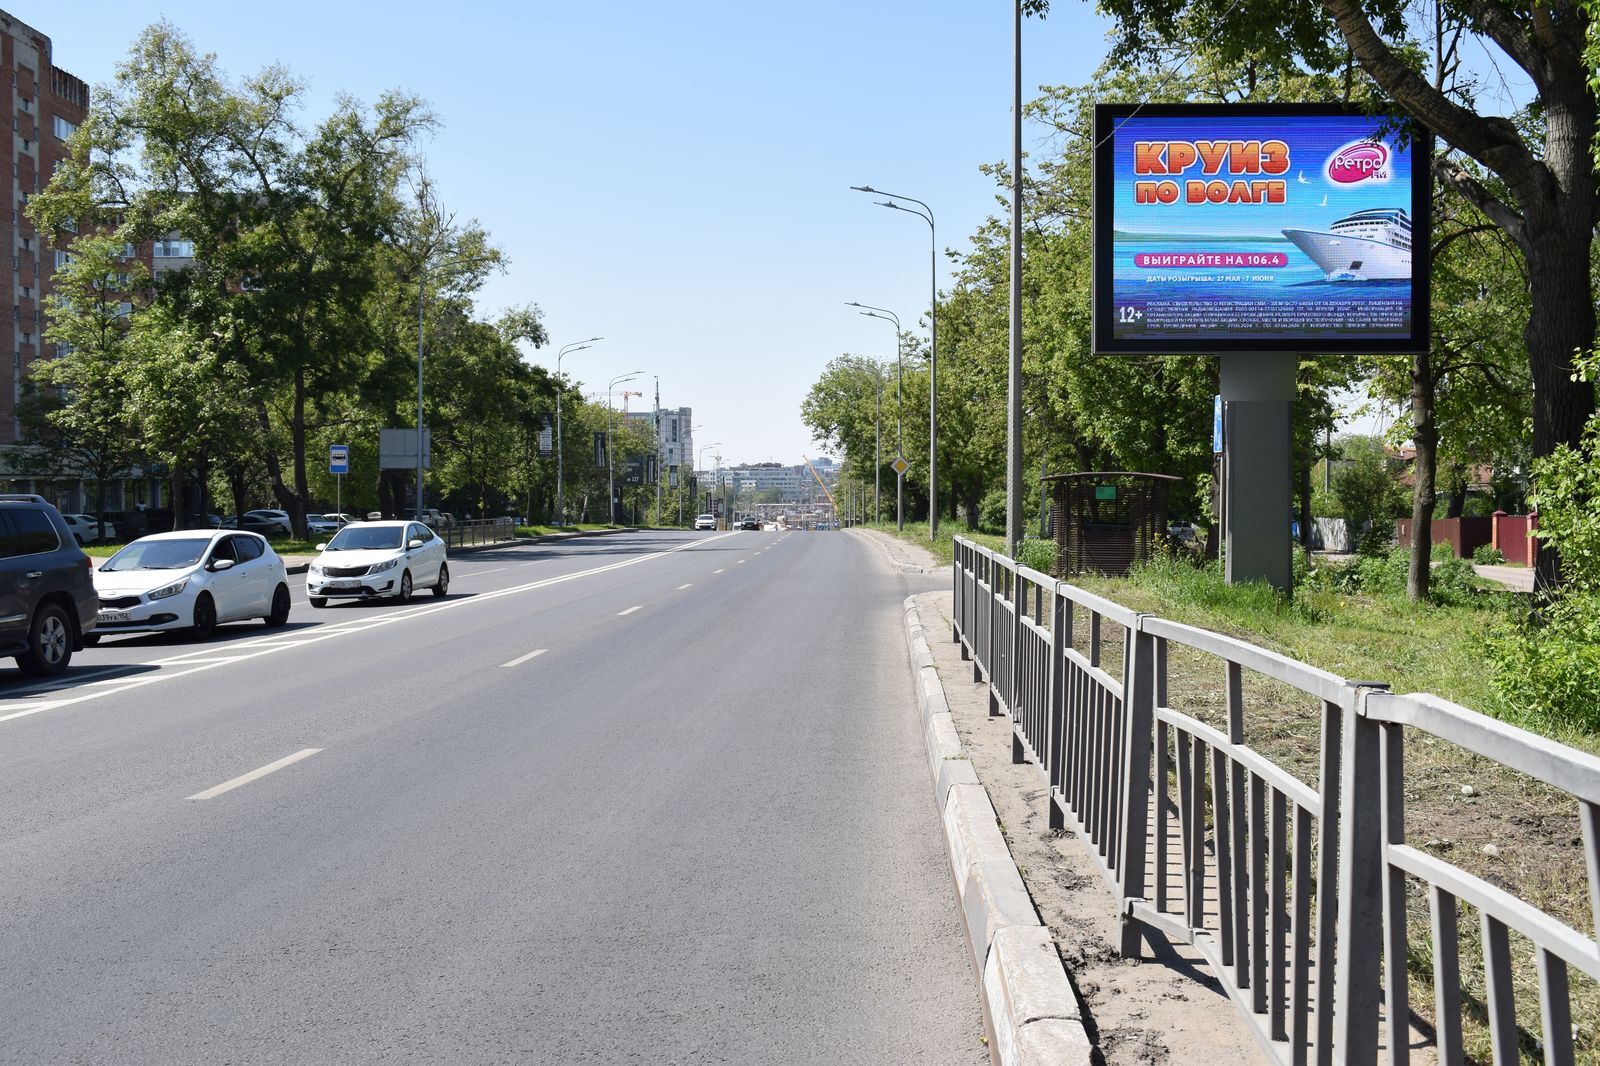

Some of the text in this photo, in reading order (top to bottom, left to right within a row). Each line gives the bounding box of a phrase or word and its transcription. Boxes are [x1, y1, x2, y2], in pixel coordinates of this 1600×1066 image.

[1135, 141, 1289, 174] КРУИЗ
[1335, 155, 1383, 172] Ретро
[1135, 181, 1286, 203] ПО ВОЛГЕ
[1143, 254, 1280, 265] ВЫИГРАЙТЕ НА 106.4
[1119, 306, 1143, 323] 12+
